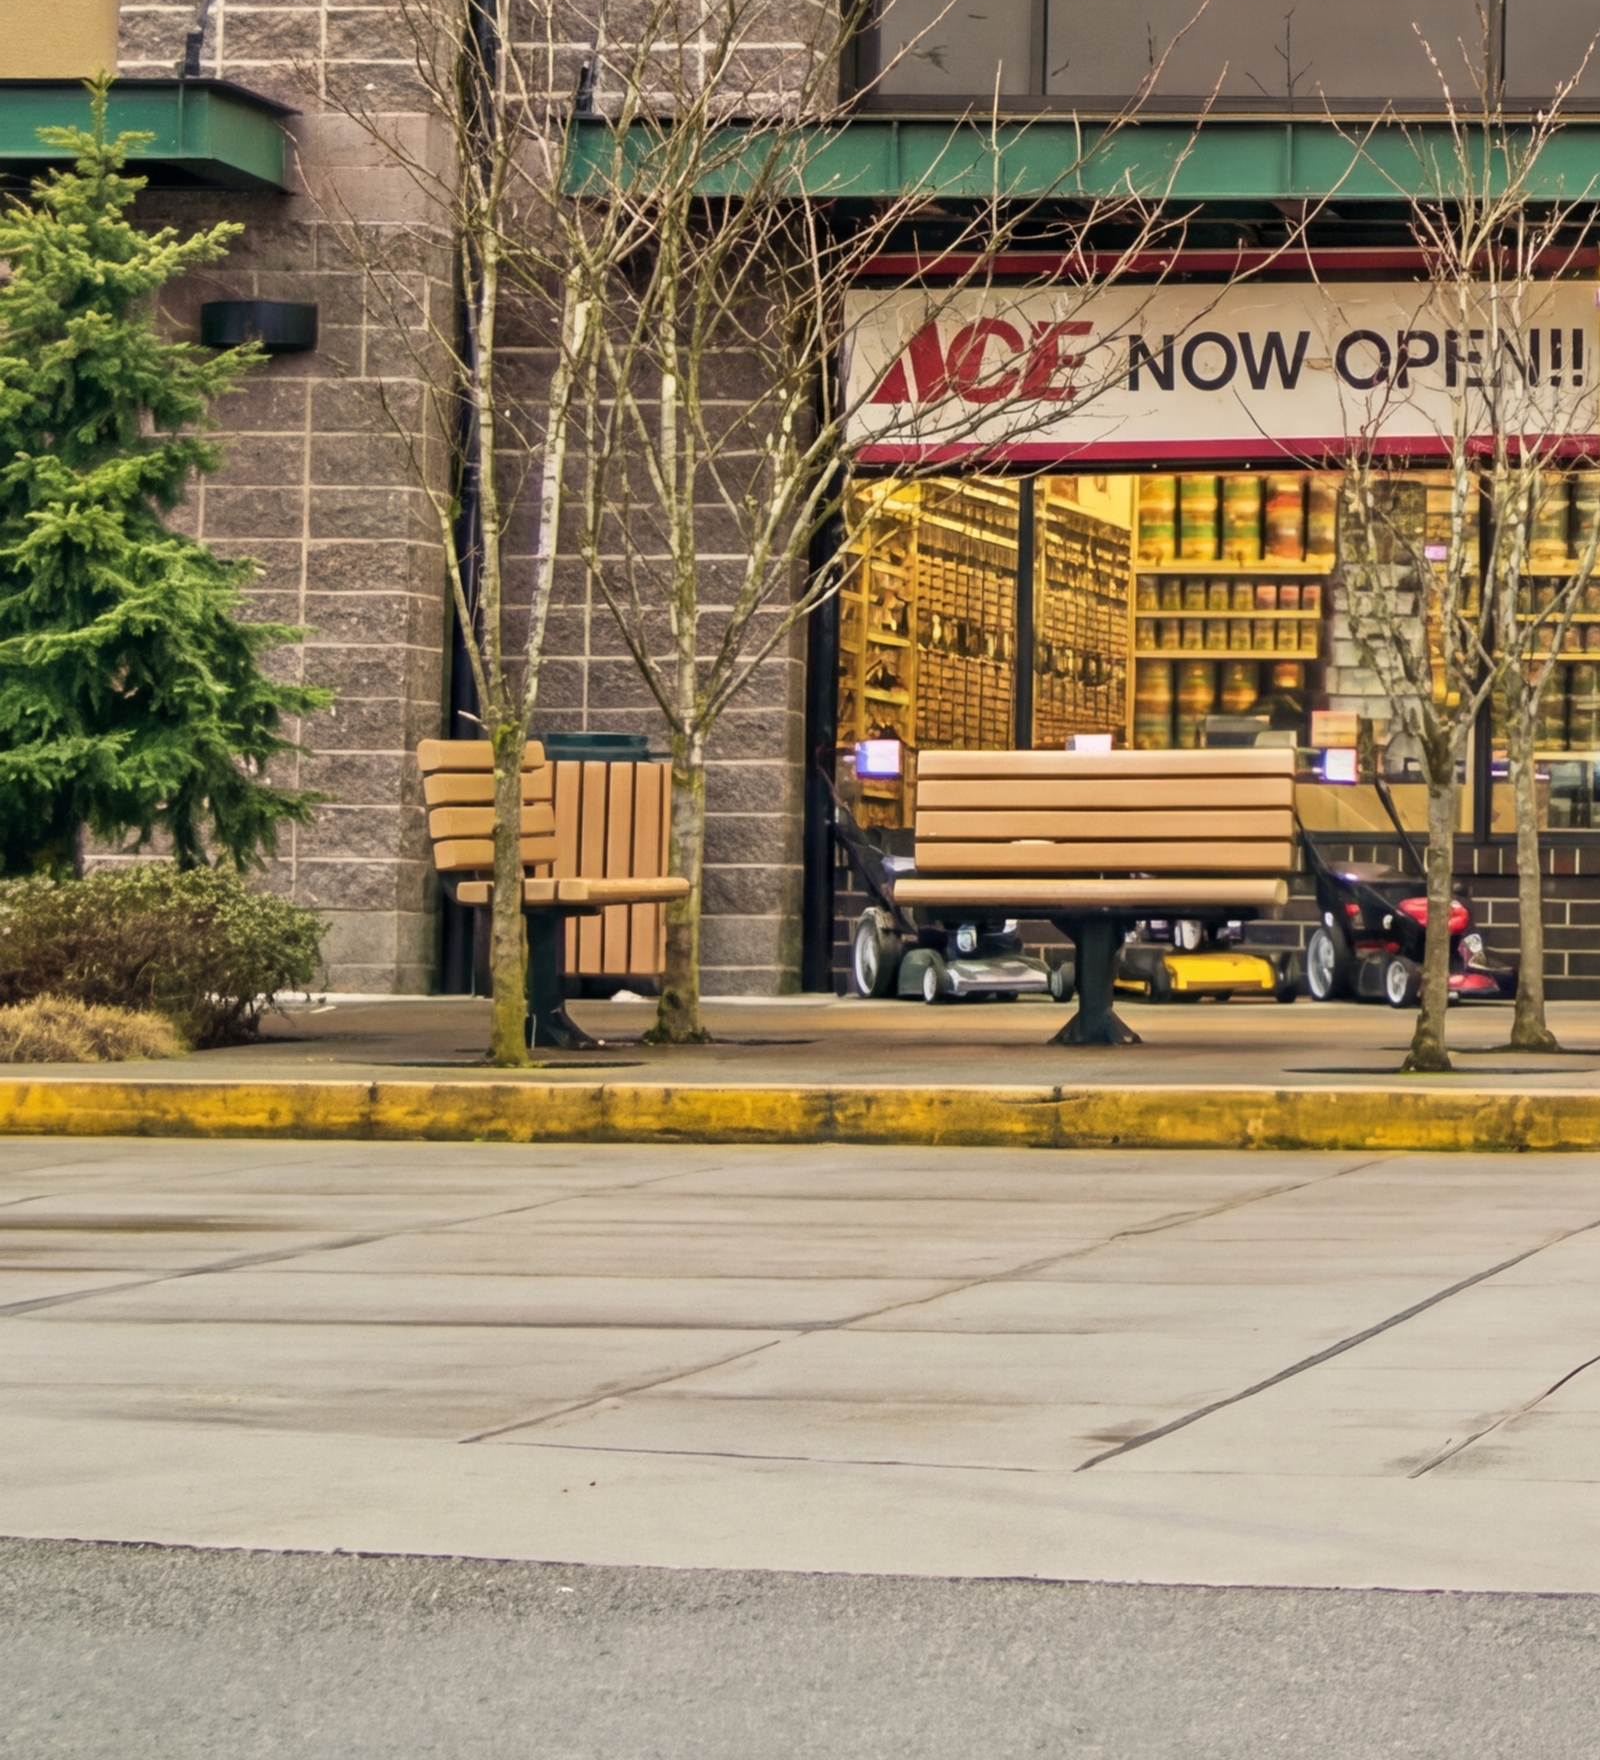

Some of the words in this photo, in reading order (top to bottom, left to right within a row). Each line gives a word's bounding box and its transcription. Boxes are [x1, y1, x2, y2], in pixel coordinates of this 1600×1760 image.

[868, 316, 1094, 404] ACE
[1128, 331, 1311, 392] NOW
[1335, 328, 1585, 390] OPEN!!
